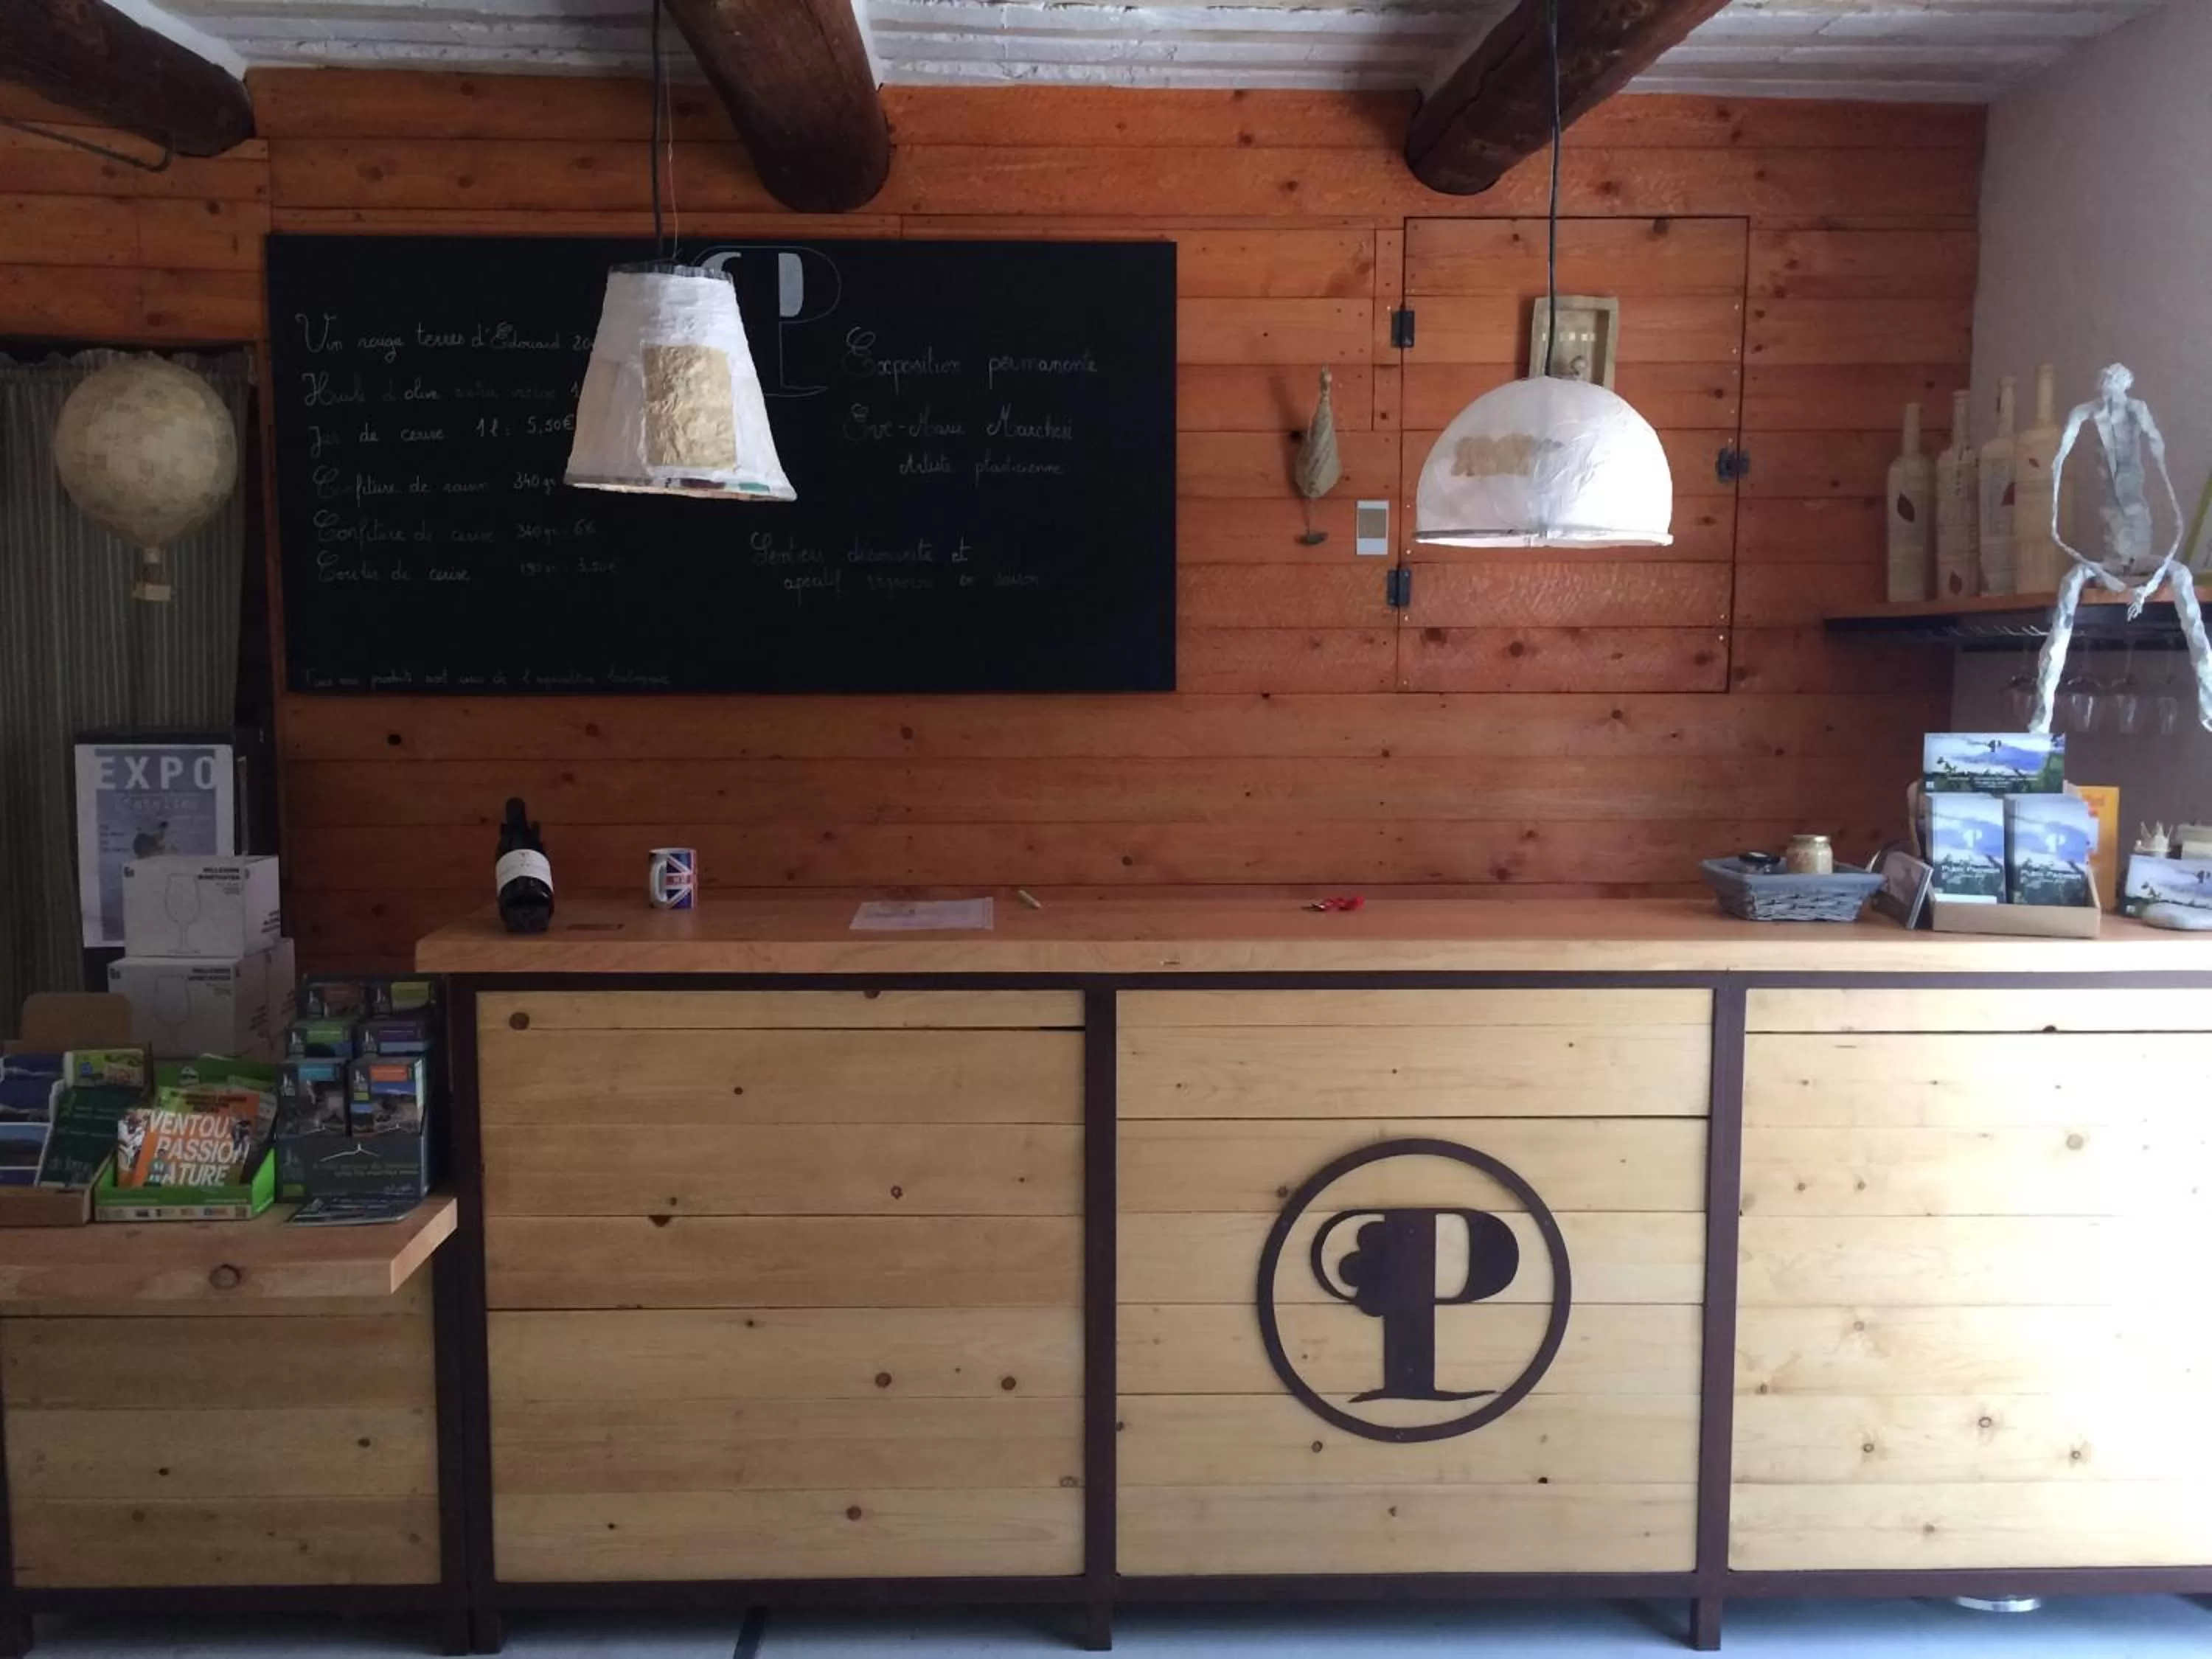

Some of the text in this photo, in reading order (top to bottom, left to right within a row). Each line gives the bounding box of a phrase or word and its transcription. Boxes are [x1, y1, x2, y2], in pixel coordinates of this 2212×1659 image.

[94, 755, 218, 790] EXPO
[147, 1109, 234, 1139] VENTOU
[158, 1161, 230, 1187] ATURE
